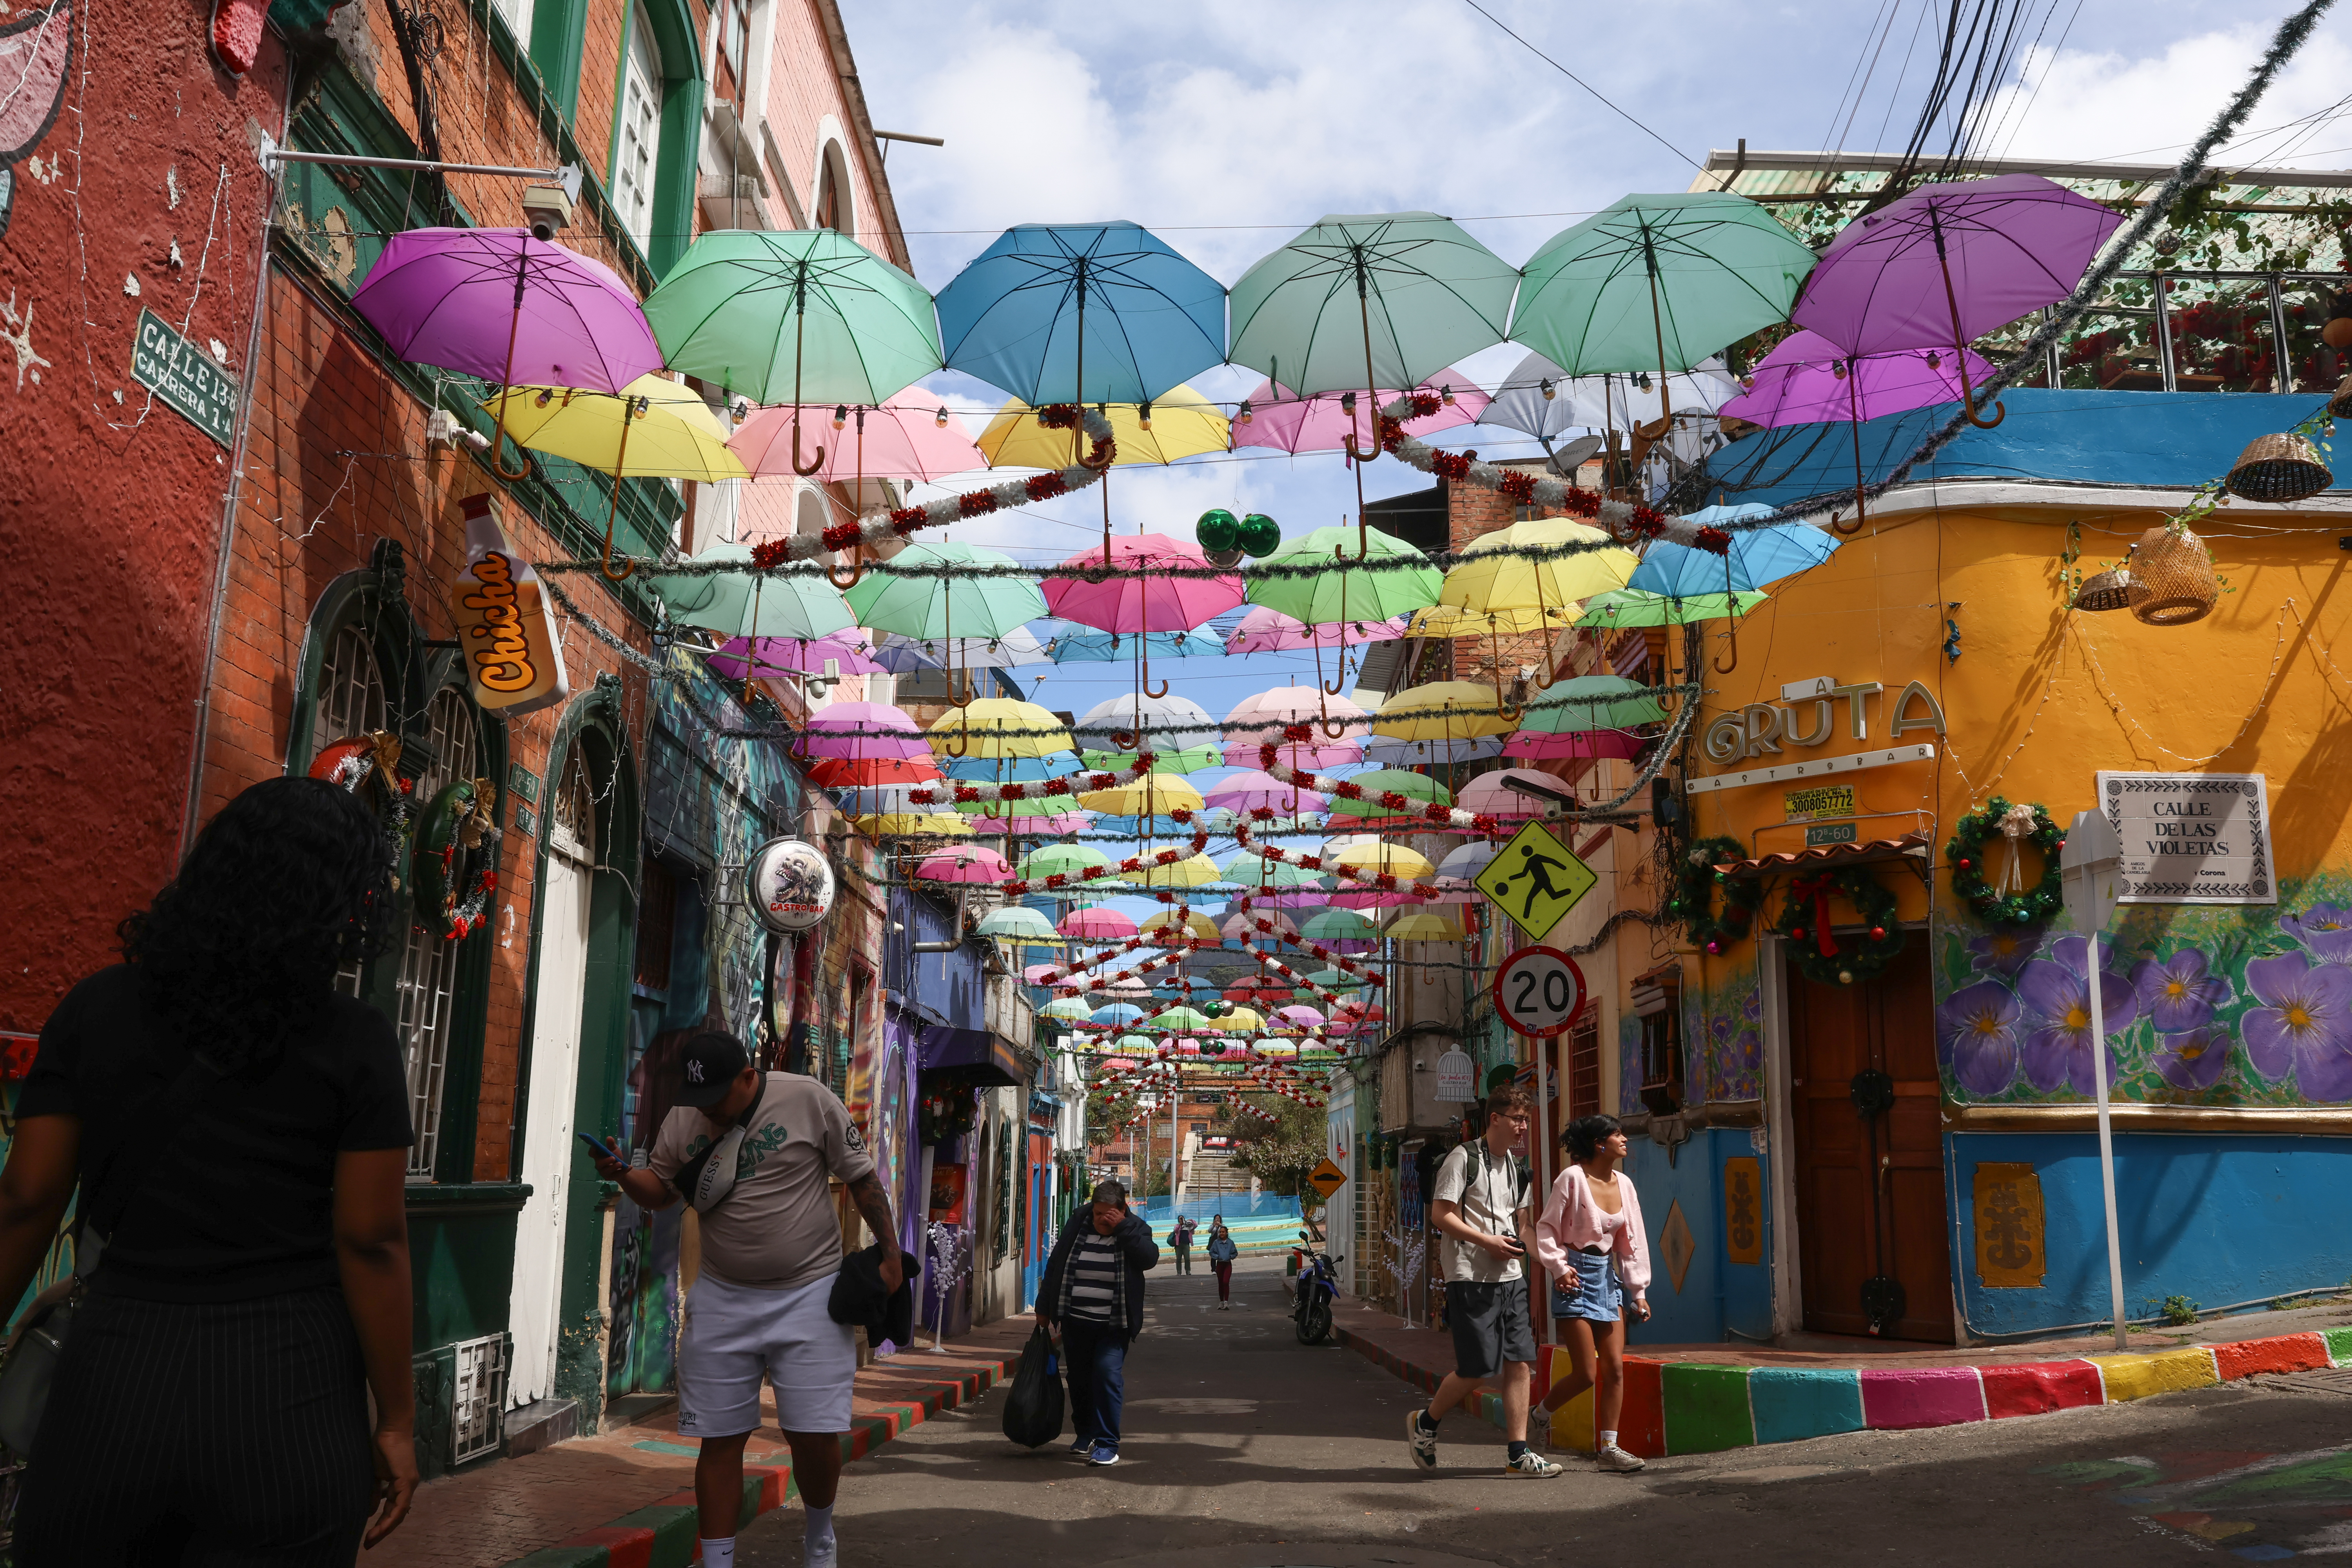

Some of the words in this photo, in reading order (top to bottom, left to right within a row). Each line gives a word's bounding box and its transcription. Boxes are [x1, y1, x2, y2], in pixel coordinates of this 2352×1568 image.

[143, 323, 209, 392] CALLE
[137, 353, 206, 418] CARRERA
[1561, 443, 1595, 457] DIRECTV
[463, 552, 537, 693] Chicha
[1782, 679, 1827, 701] LA
[1702, 680, 1946, 764] GRUTA
[1786, 791, 1829, 802] CUADRANTE
[1792, 794, 1853, 813] 3008057772
[2153, 802, 2212, 816] CALLE
[2155, 823, 2179, 836] DE
[2181, 823, 2216, 837] LAS
[2146, 840, 2229, 855] VIOLETAS
[770, 902, 807, 913] GASTRO
[809, 904, 825, 915] BAR
[1512, 970, 1569, 1013] 20
